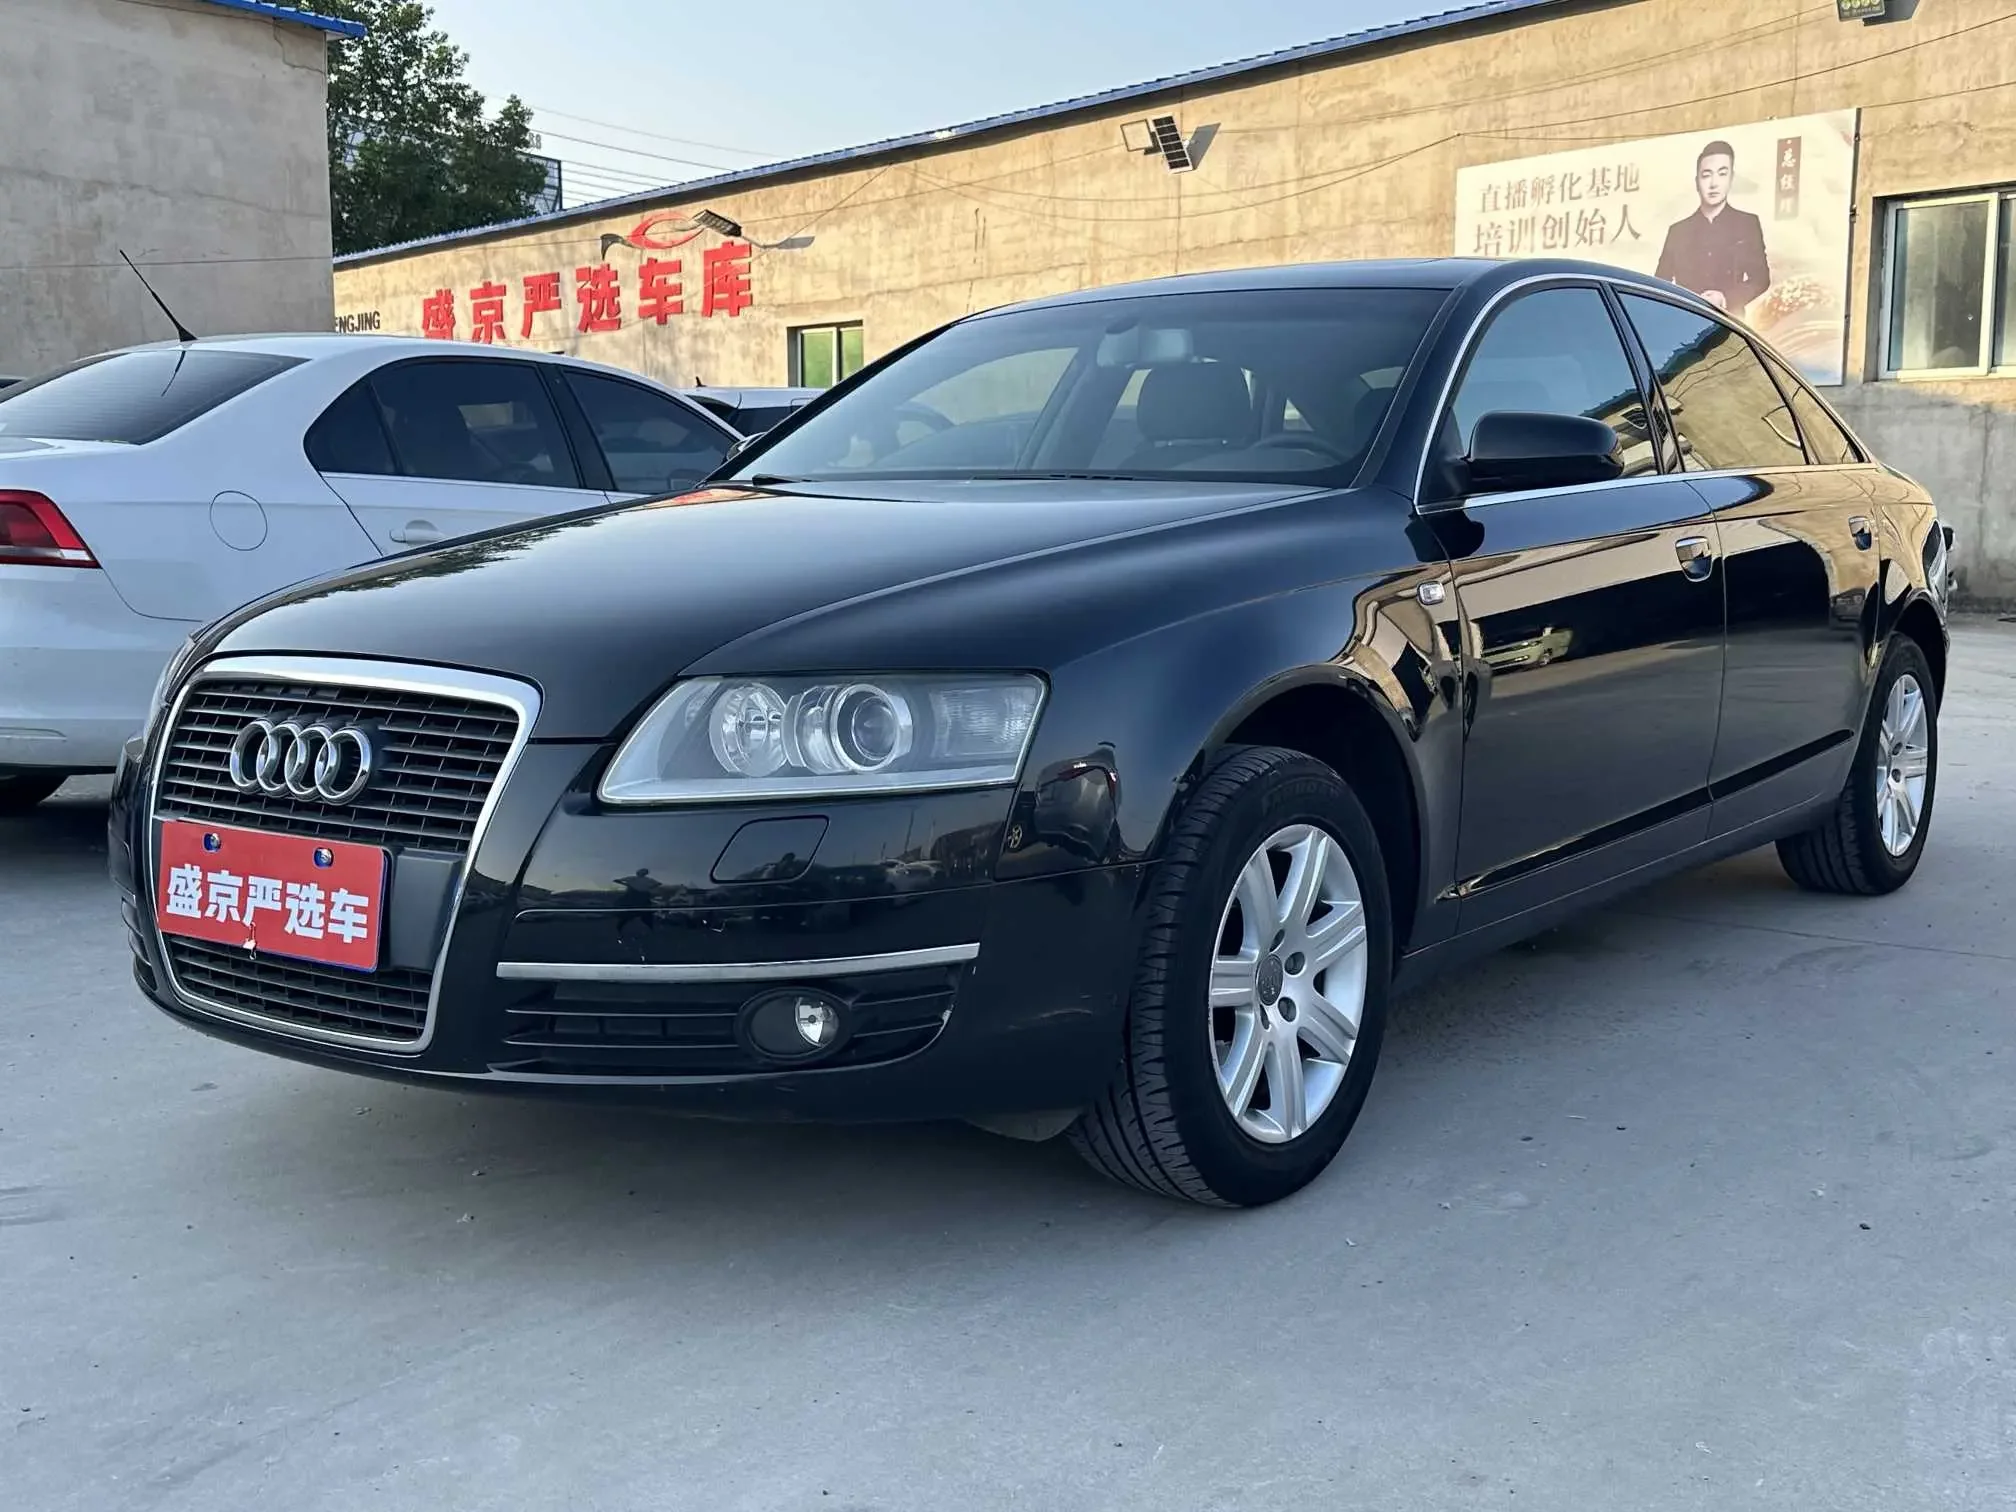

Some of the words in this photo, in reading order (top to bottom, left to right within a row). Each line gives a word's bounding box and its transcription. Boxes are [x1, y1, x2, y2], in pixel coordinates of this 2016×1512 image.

[1477, 162, 1640, 213] 直播孵化基地
[1473, 203, 1641, 256] 培训创始人
[421, 241, 753, 344] 盛京严选车库
[166, 863, 369, 944] 盛京严选车
